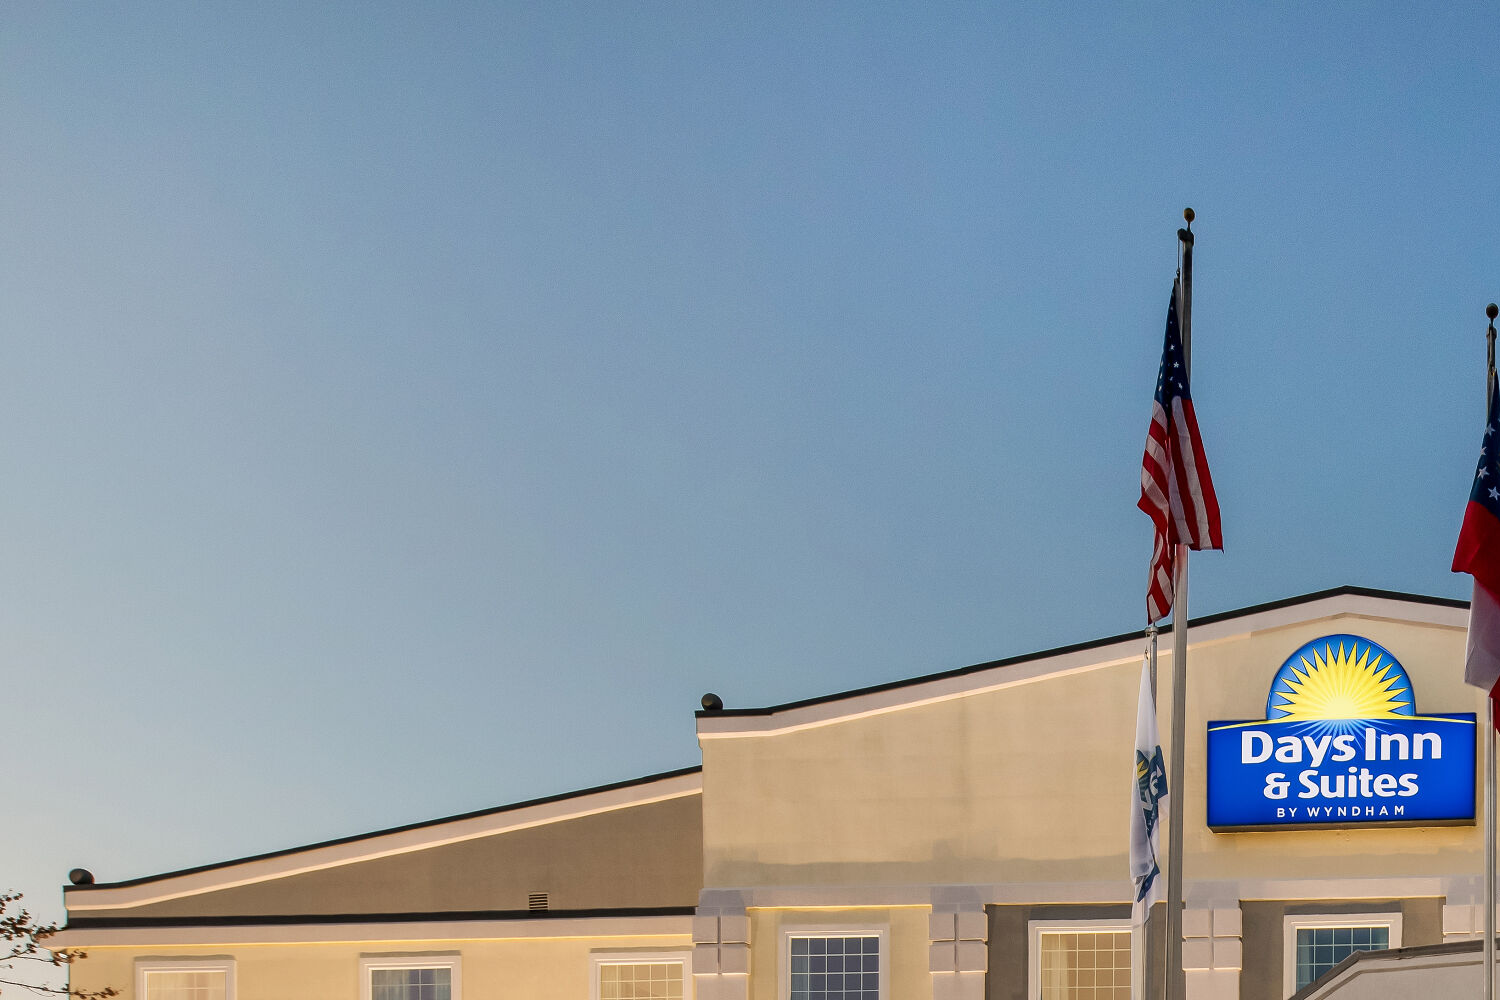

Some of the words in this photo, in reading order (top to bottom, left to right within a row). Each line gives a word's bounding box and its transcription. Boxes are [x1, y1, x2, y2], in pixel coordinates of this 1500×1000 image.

[1241, 730, 1356, 768] Days
[1365, 727, 1442, 761] Inn
[1263, 772, 1291, 800] &
[1297, 766, 1419, 799] Suites
[1276, 807, 1298, 818] BY
[1307, 805, 1405, 817] WYNDHAM
